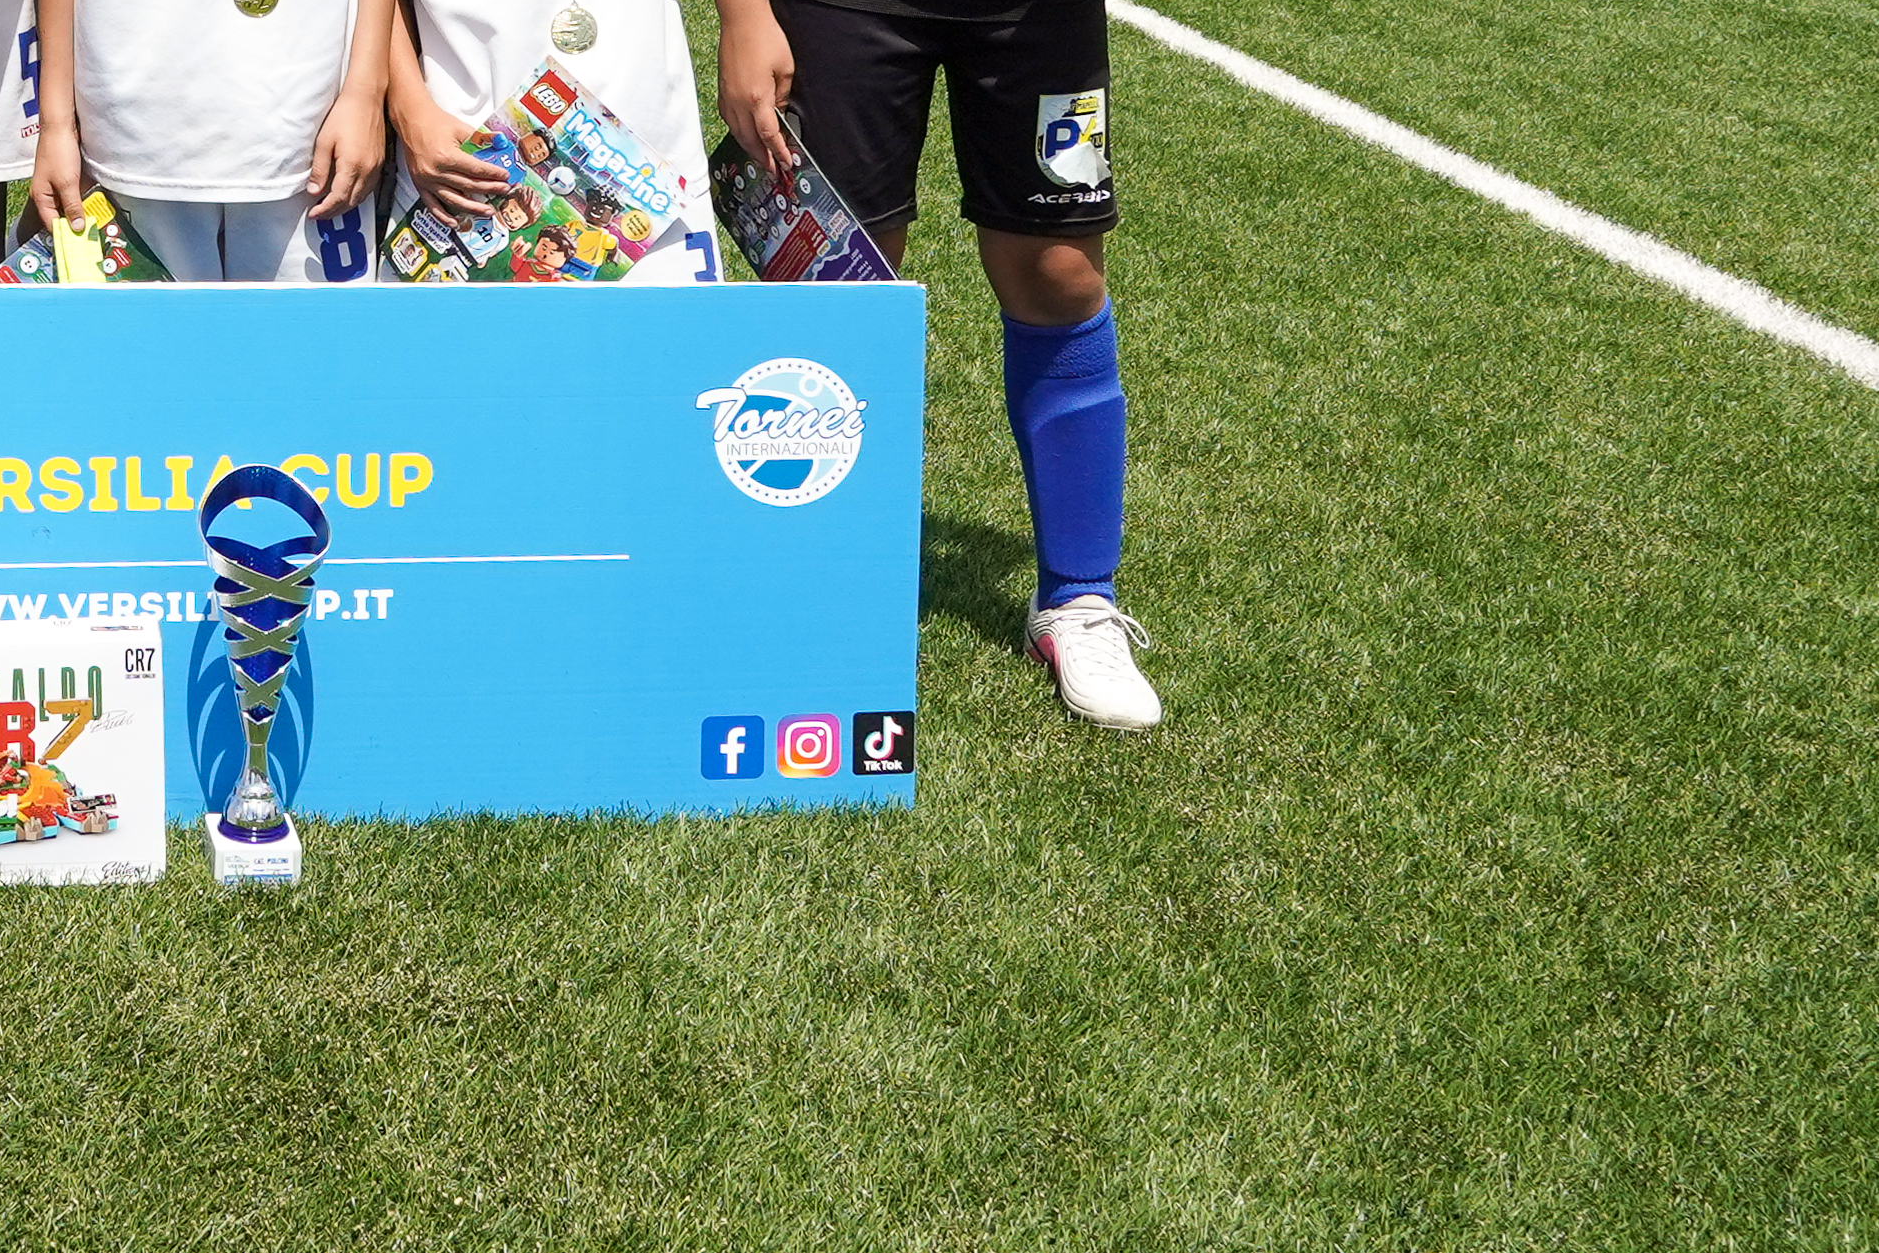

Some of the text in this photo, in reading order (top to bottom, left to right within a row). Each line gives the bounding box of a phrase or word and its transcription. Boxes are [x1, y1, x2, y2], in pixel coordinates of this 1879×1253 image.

[532, 85, 564, 113] LEGO
[499, 154, 512, 168] 10
[567, 110, 667, 212] Magazine
[316, 206, 368, 282] 8
[477, 226, 492, 243] 10
[695, 387, 868, 442] Tornei
[726, 442, 852, 456] INTERNAZIONALI
[280, 453, 433, 508] CUP
[125, 648, 155, 672] CR7
[864, 760, 903, 771] TikTok
